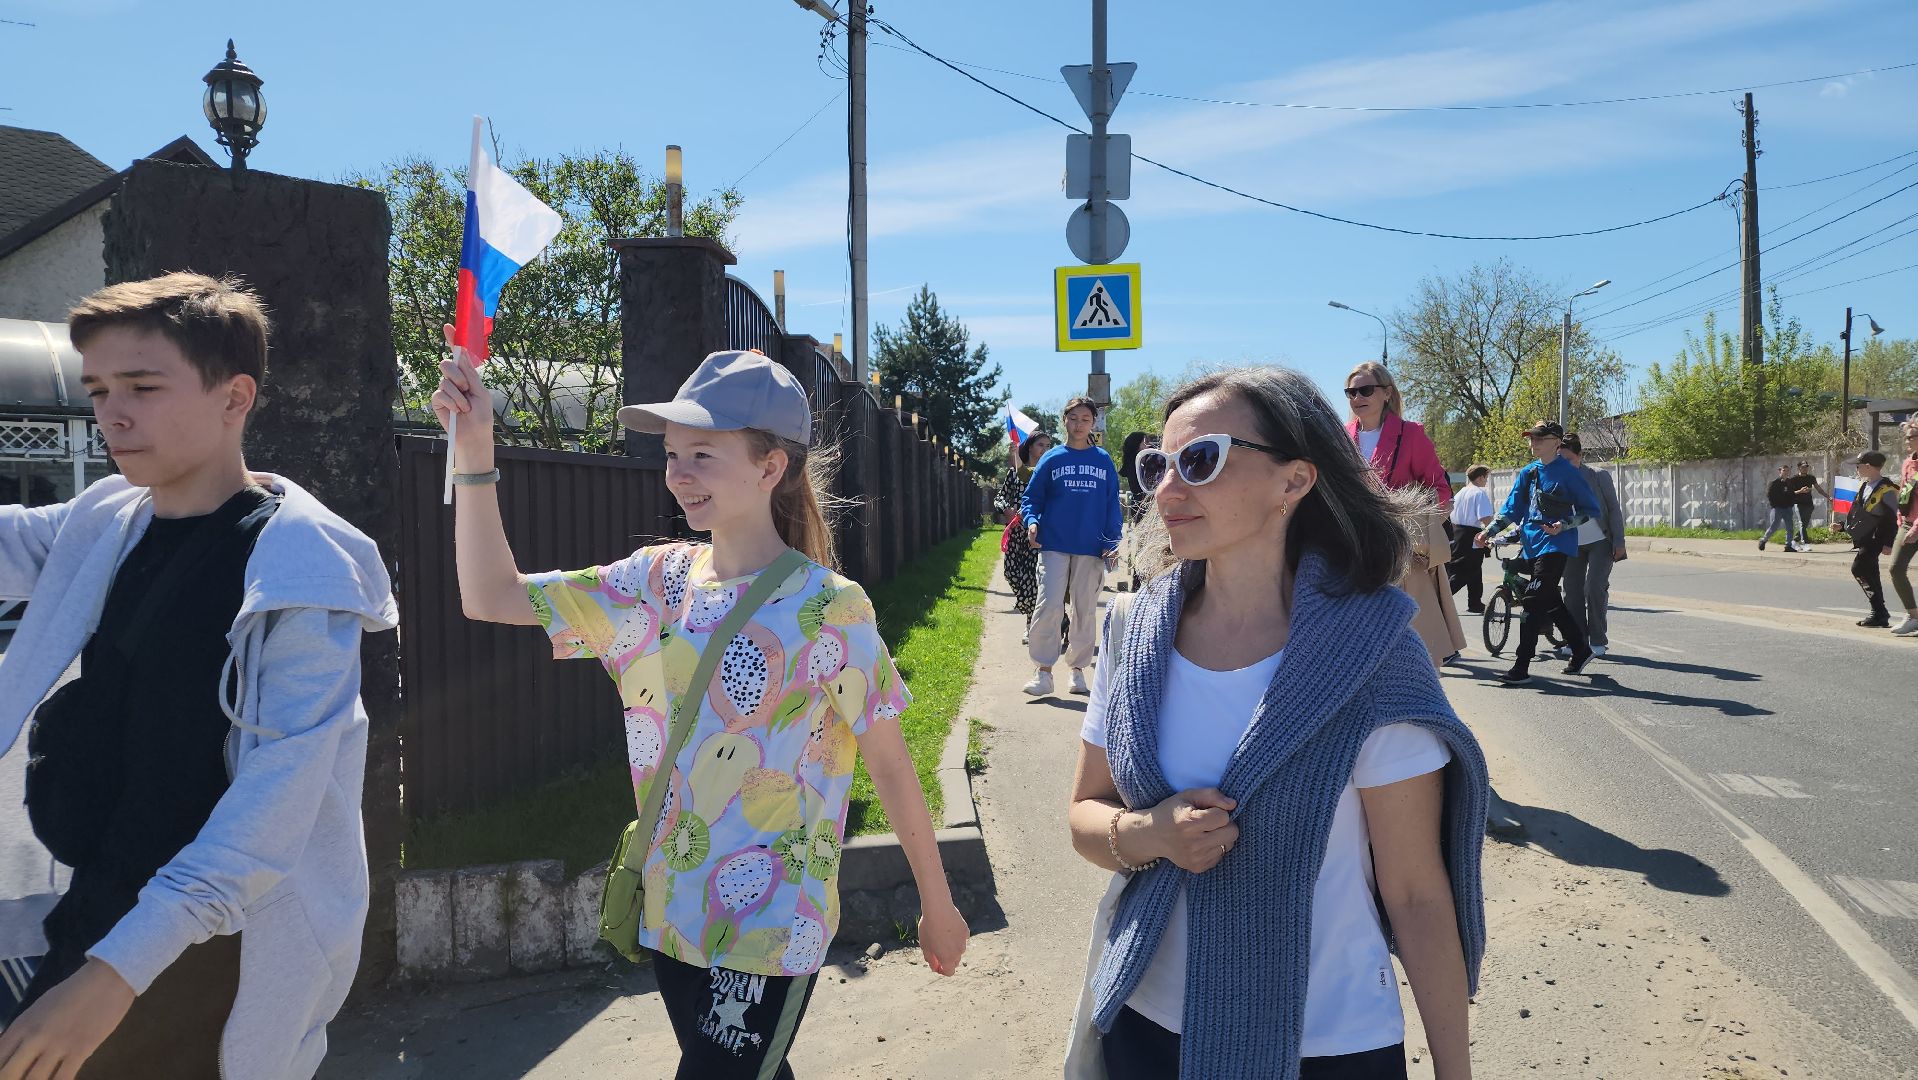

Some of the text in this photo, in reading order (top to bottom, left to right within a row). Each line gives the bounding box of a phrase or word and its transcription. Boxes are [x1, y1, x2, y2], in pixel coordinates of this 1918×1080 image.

[1051, 465, 1107, 480] CHASE DREAM
[1064, 480, 1096, 488] TRAVELER
[710, 967, 767, 1004] BORN
